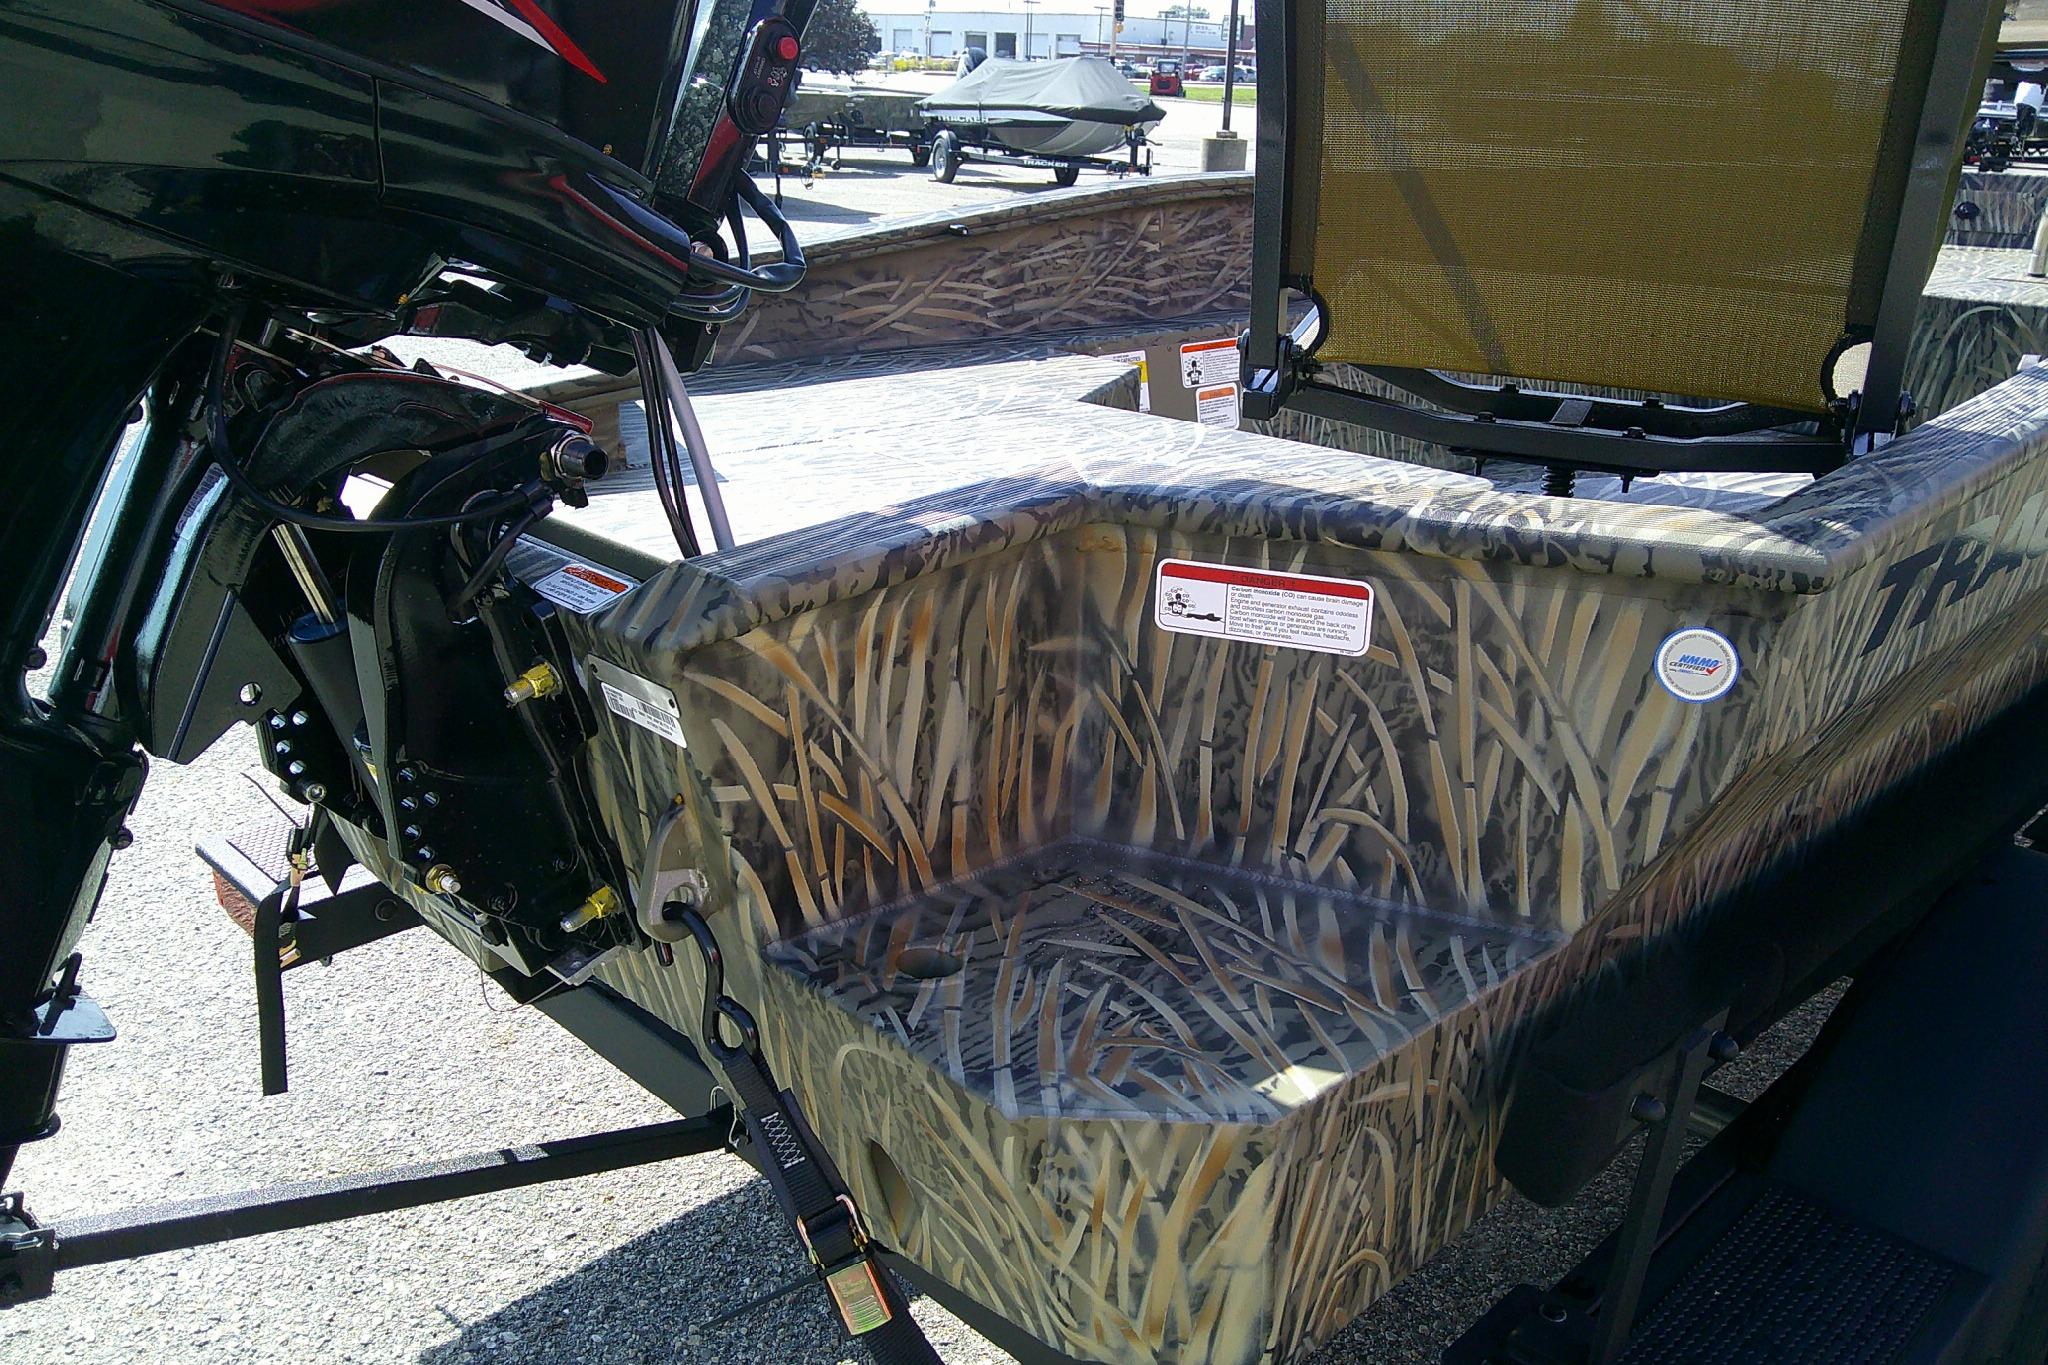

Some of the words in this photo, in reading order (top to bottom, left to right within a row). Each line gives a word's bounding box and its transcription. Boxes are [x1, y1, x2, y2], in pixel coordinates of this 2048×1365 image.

[1023, 159, 1069, 168] TRACKER
[1241, 576, 1286, 588] DANGER
[1669, 661, 1706, 671] CERTIFIED
